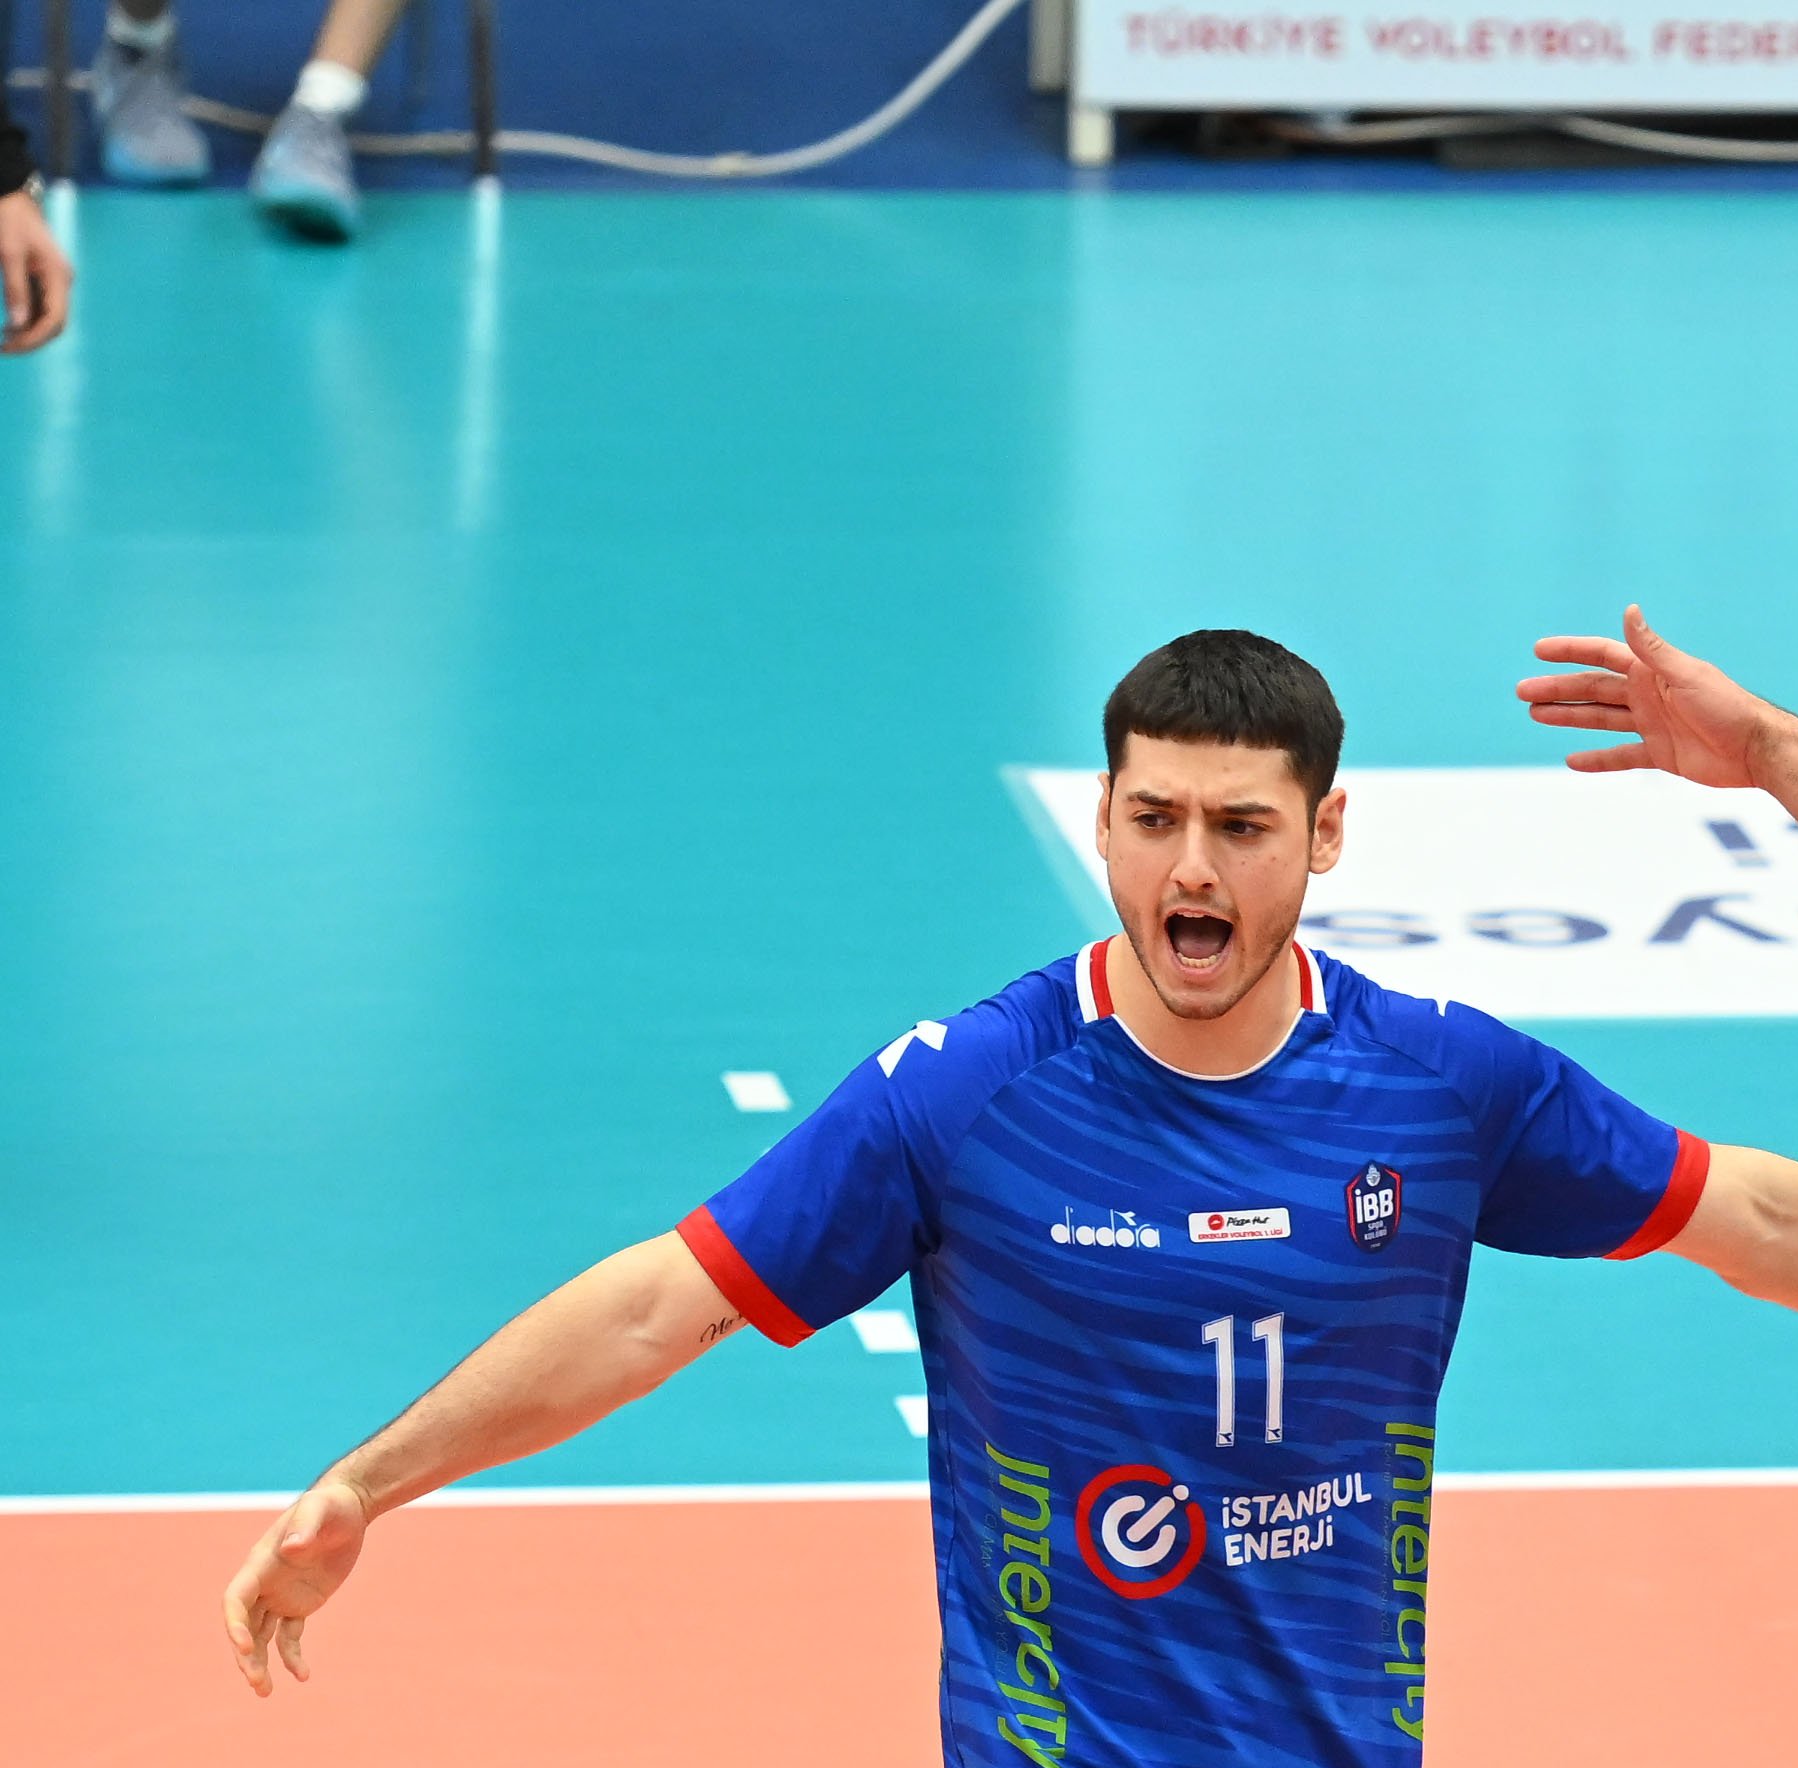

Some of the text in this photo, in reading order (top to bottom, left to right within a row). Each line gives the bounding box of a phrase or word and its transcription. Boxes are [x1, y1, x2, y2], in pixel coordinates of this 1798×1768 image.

[1366, 15, 1636, 62] VOLEYBOL
[1050, 1206, 1161, 1248] diadora
[1201, 1312, 1285, 1448] 11
